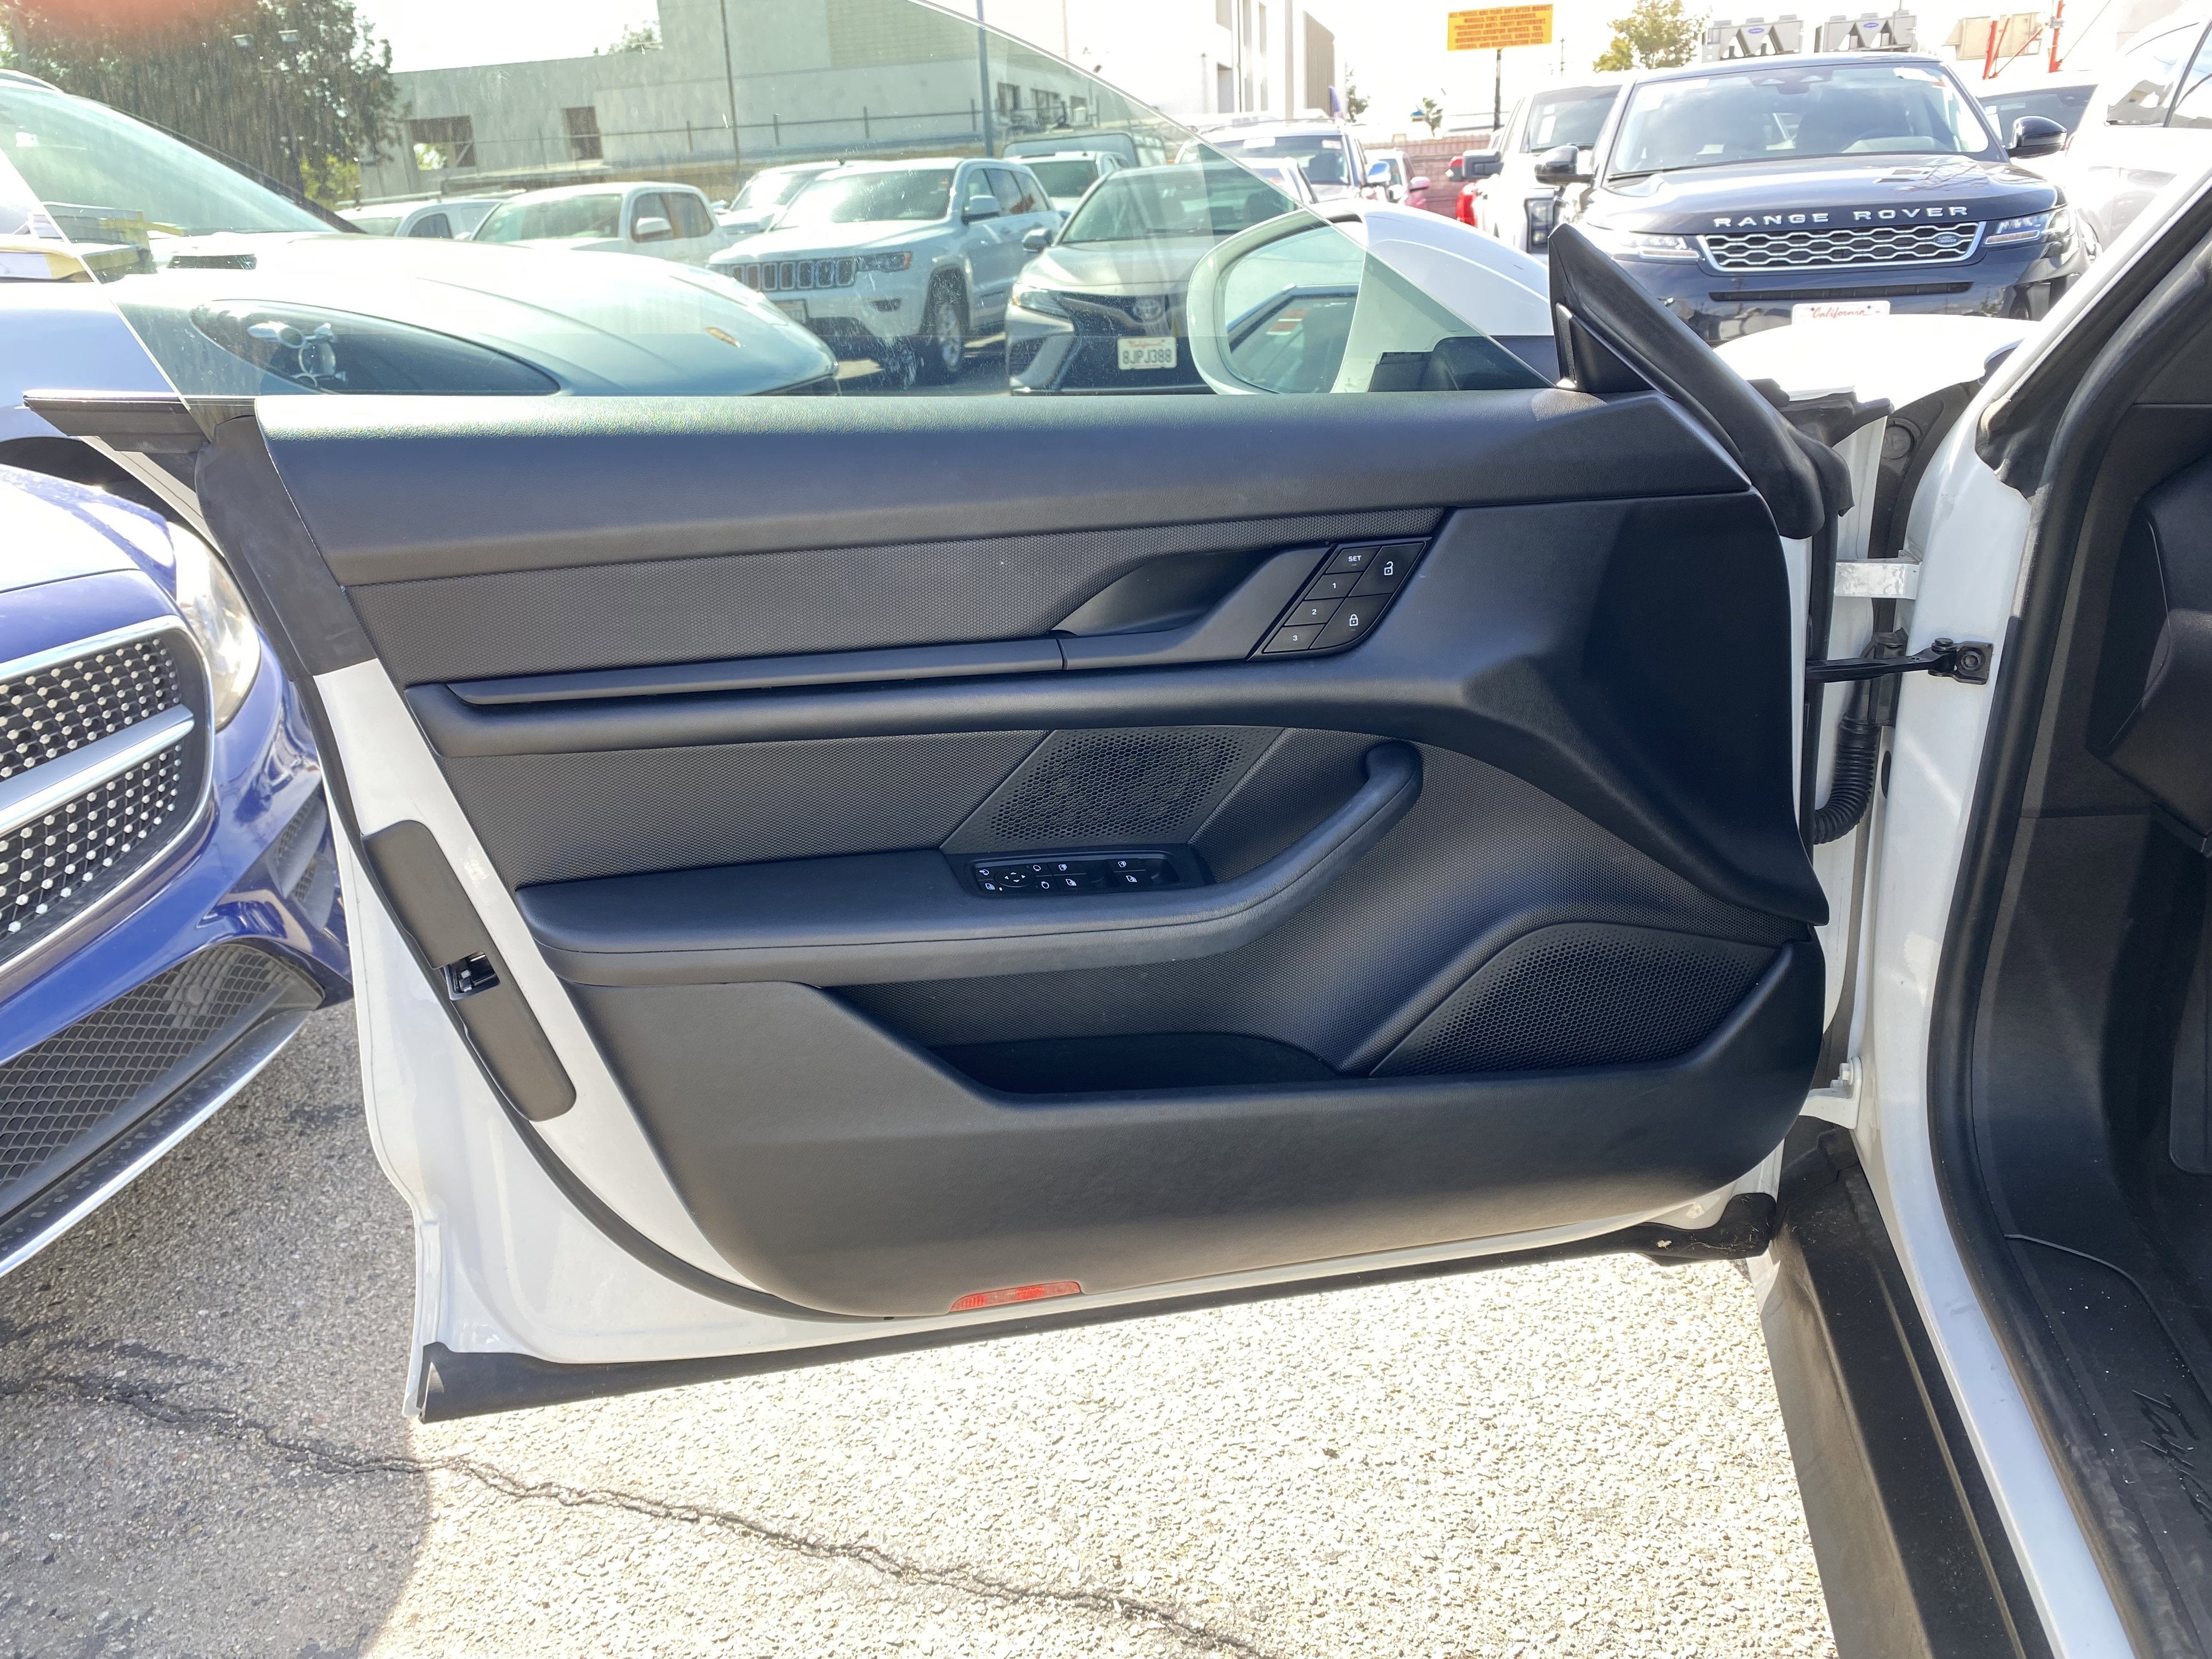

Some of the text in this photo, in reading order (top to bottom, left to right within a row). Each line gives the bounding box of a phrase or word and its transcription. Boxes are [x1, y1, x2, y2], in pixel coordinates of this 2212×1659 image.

[1713, 206, 1967, 228] RANGE ROVER
[1812, 307, 1865, 318] California
